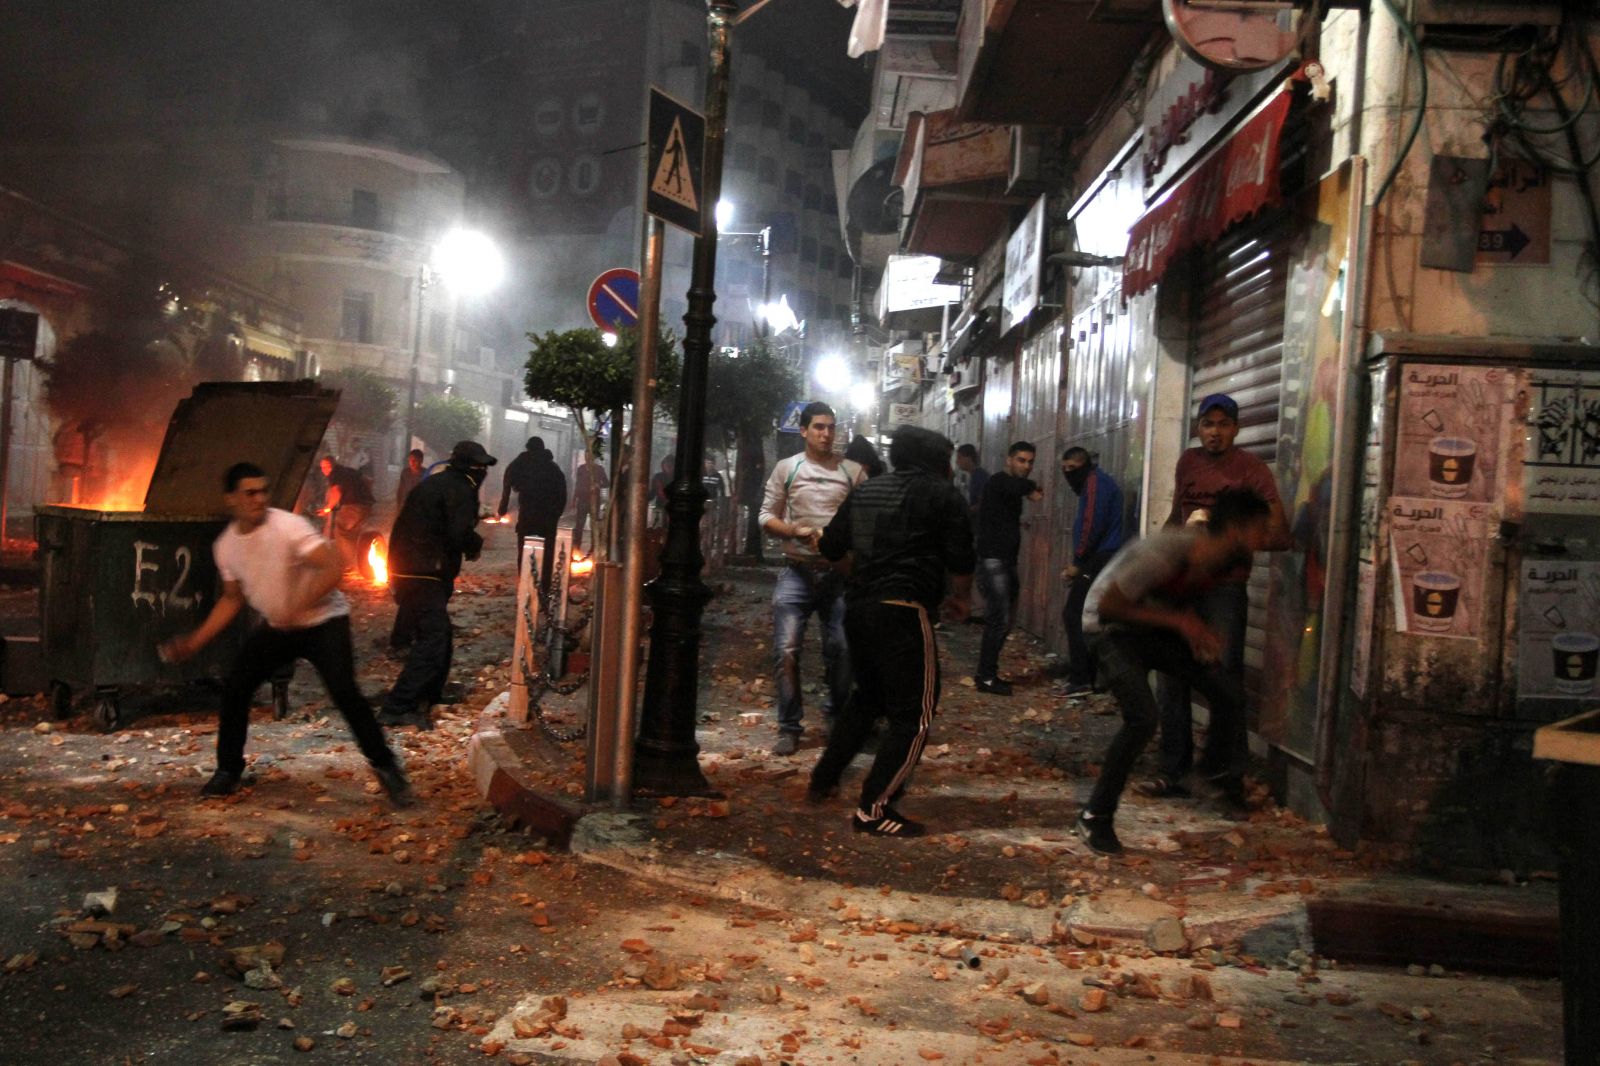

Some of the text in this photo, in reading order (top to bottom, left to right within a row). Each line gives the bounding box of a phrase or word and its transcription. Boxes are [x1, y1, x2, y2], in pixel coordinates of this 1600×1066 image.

[1409, 371, 1458, 387] الحرية
[1393, 505, 1443, 521] الحرية
[1528, 568, 1578, 584] الحرية
